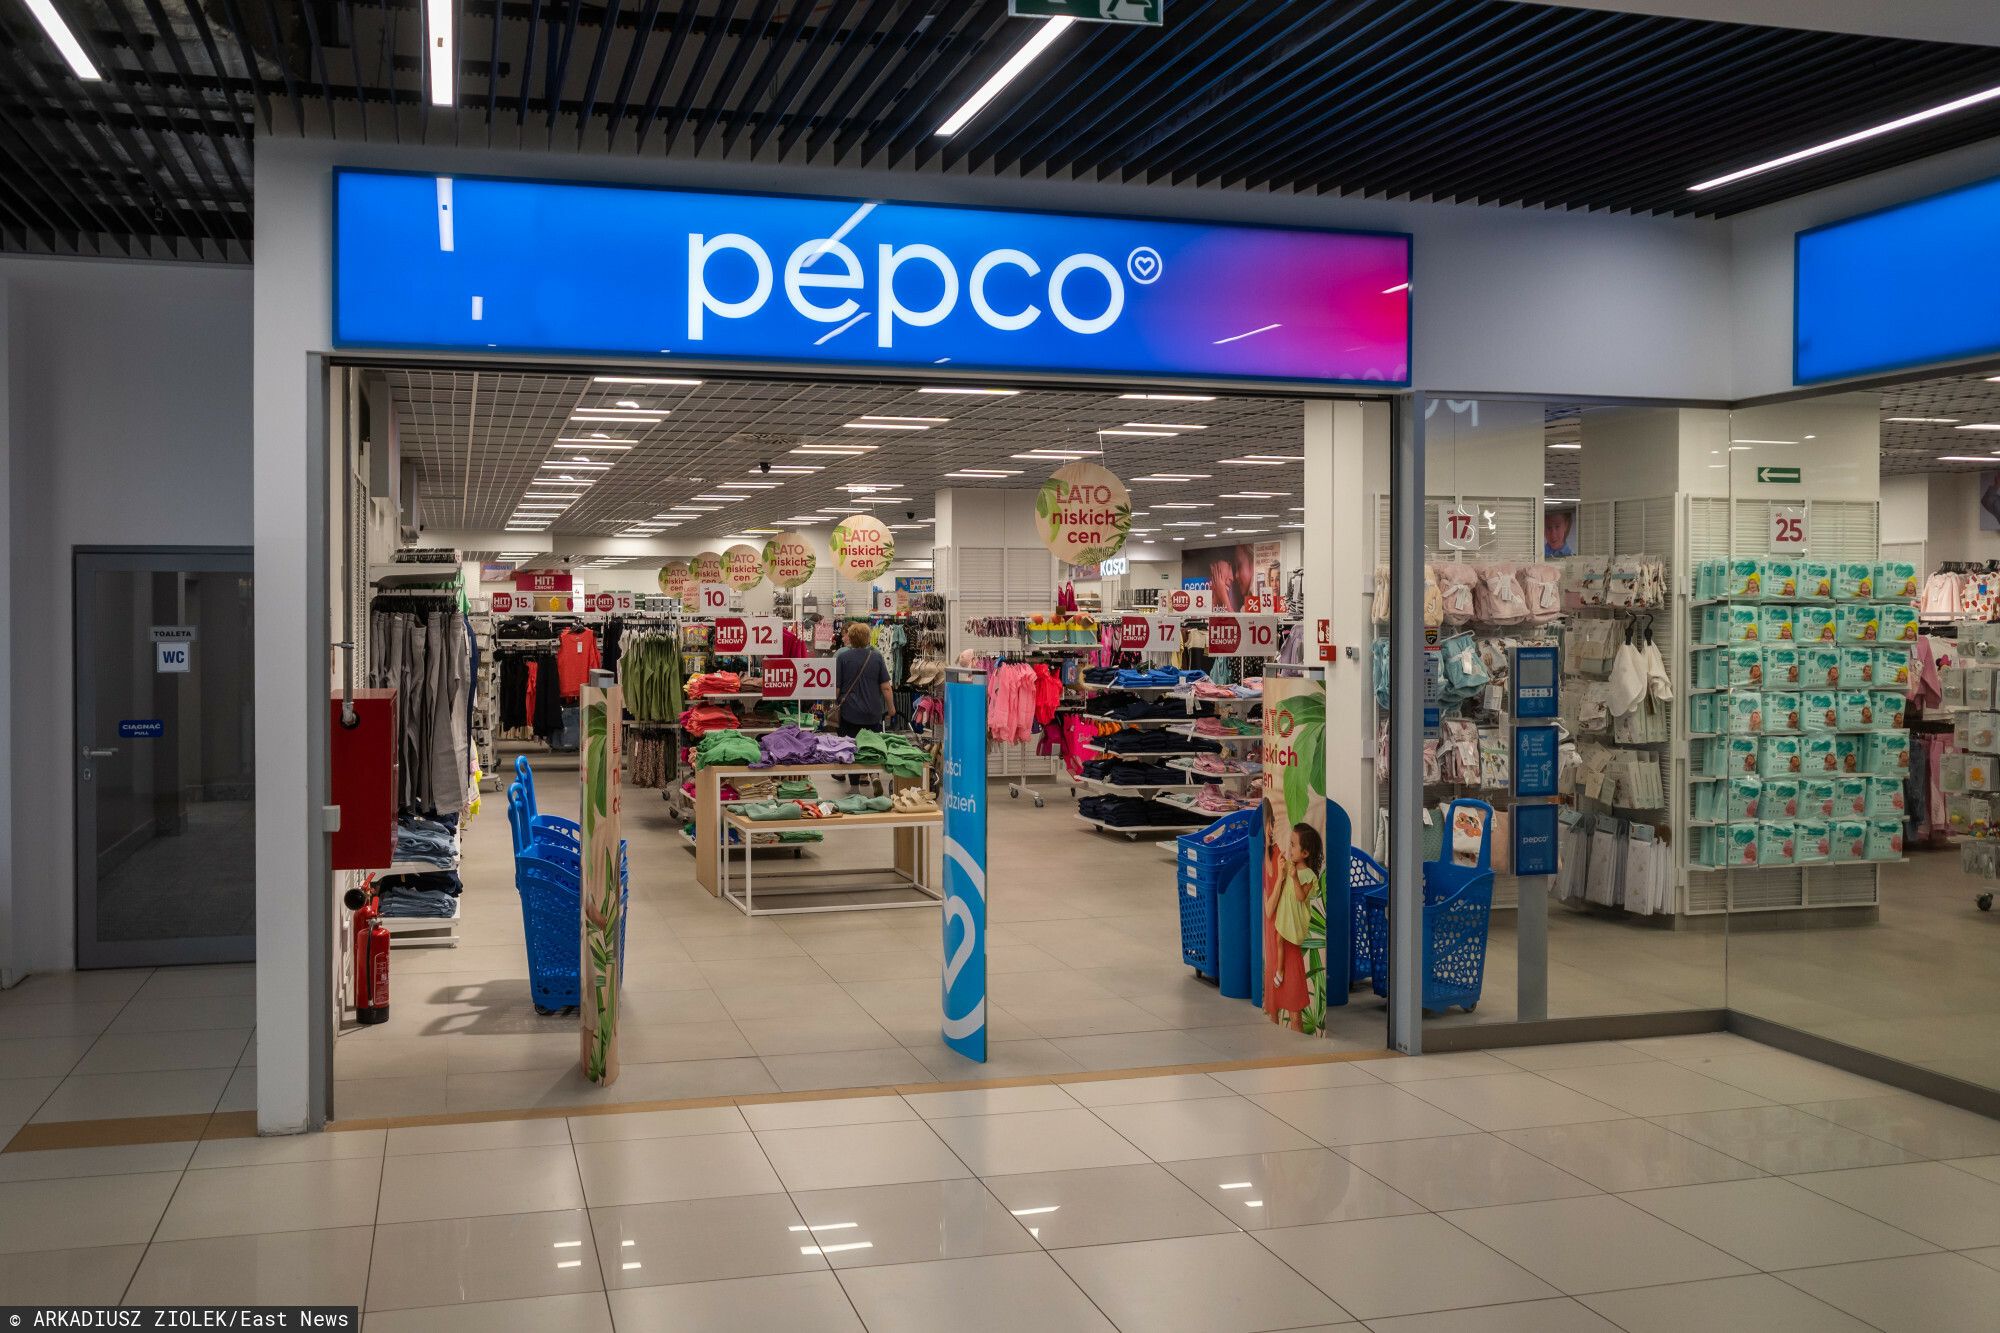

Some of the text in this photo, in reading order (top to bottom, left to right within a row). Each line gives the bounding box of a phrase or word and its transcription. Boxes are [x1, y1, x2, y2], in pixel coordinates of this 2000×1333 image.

[688, 233, 1124, 348] pepco
[1056, 484, 1111, 504] LATO
[1052, 509, 1116, 525] niskich
[1448, 515, 1471, 539] 17
[1776, 518, 1803, 542] 25
[843, 530, 880, 542] LATO
[1067, 531, 1100, 543] cen
[773, 544, 804, 555] LATO
[840, 545, 884, 555] niskich
[728, 554, 755, 563] LATO
[771, 557, 807, 567] niskich
[850, 559, 873, 567] cen
[726, 565, 757, 573] niskich
[779, 568, 798, 576] cen
[535, 576, 554, 585] HIT!
[515, 597, 528, 608] 15
[617, 597, 630, 608] 15
[704, 590, 725, 607] 10
[884, 597, 892, 608] 8
[1173, 595, 1189, 604] HIT!
[1196, 595, 1204, 608] 8
[717, 626, 744, 638] HIT!
[752, 626, 772, 644] 12
[1122, 624, 1147, 636] HIT!
[1158, 625, 1175, 641] 17
[1210, 626, 1238, 639] HIT!
[1248, 626, 1271, 645] 10
[162, 650, 185, 663] WC
[764, 668, 794, 682] HIT!
[803, 668, 831, 688] 20
